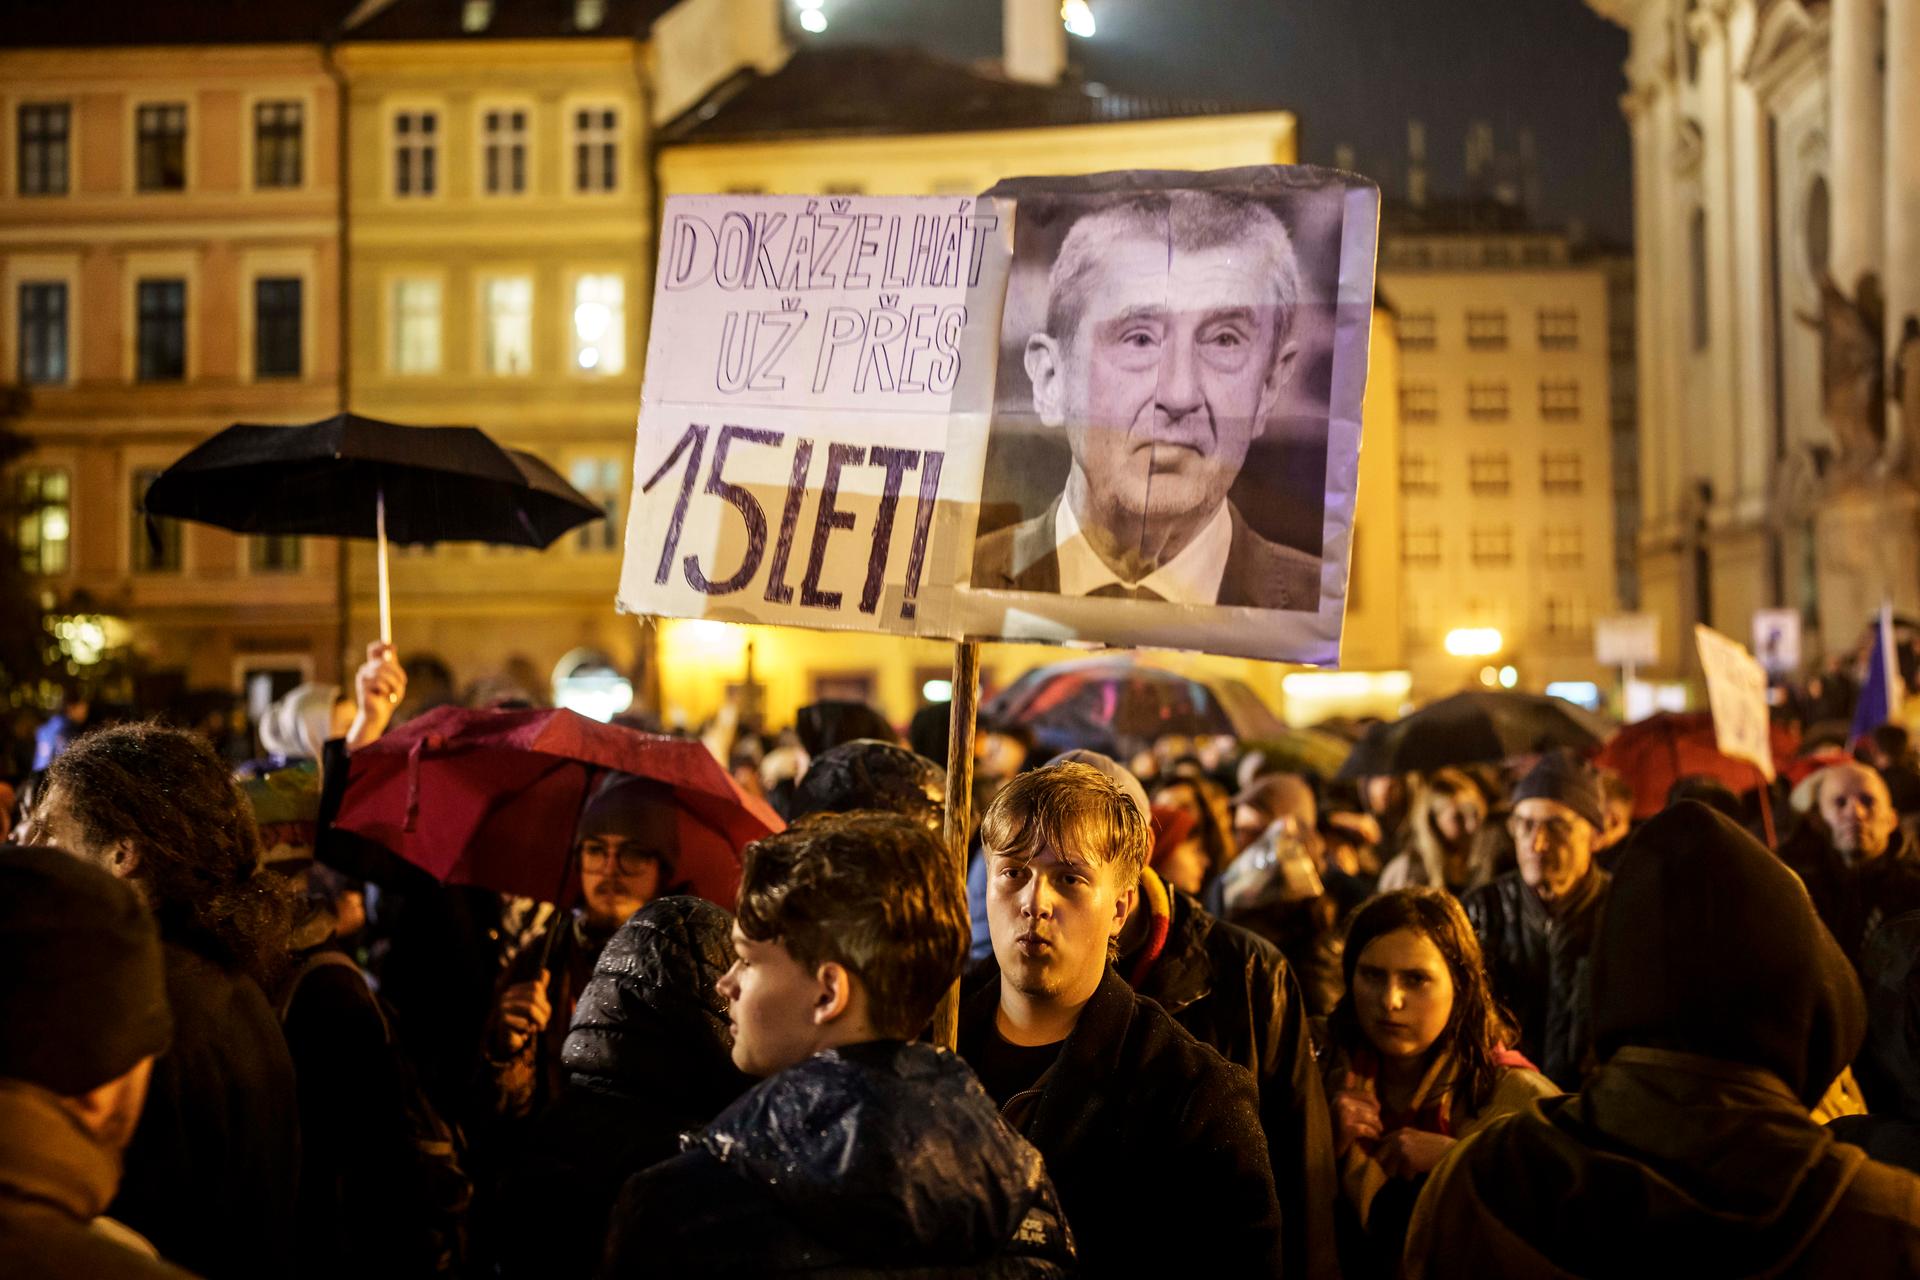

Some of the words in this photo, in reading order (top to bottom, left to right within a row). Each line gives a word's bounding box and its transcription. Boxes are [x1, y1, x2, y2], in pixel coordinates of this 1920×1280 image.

[665, 200, 883, 291] DOKÁŽE
[881, 200, 999, 288] LHÁT
[716, 297, 809, 394] UŽ
[812, 293, 968, 394] PŘES
[642, 424, 784, 595] 15
[764, 437, 945, 619] LET!
